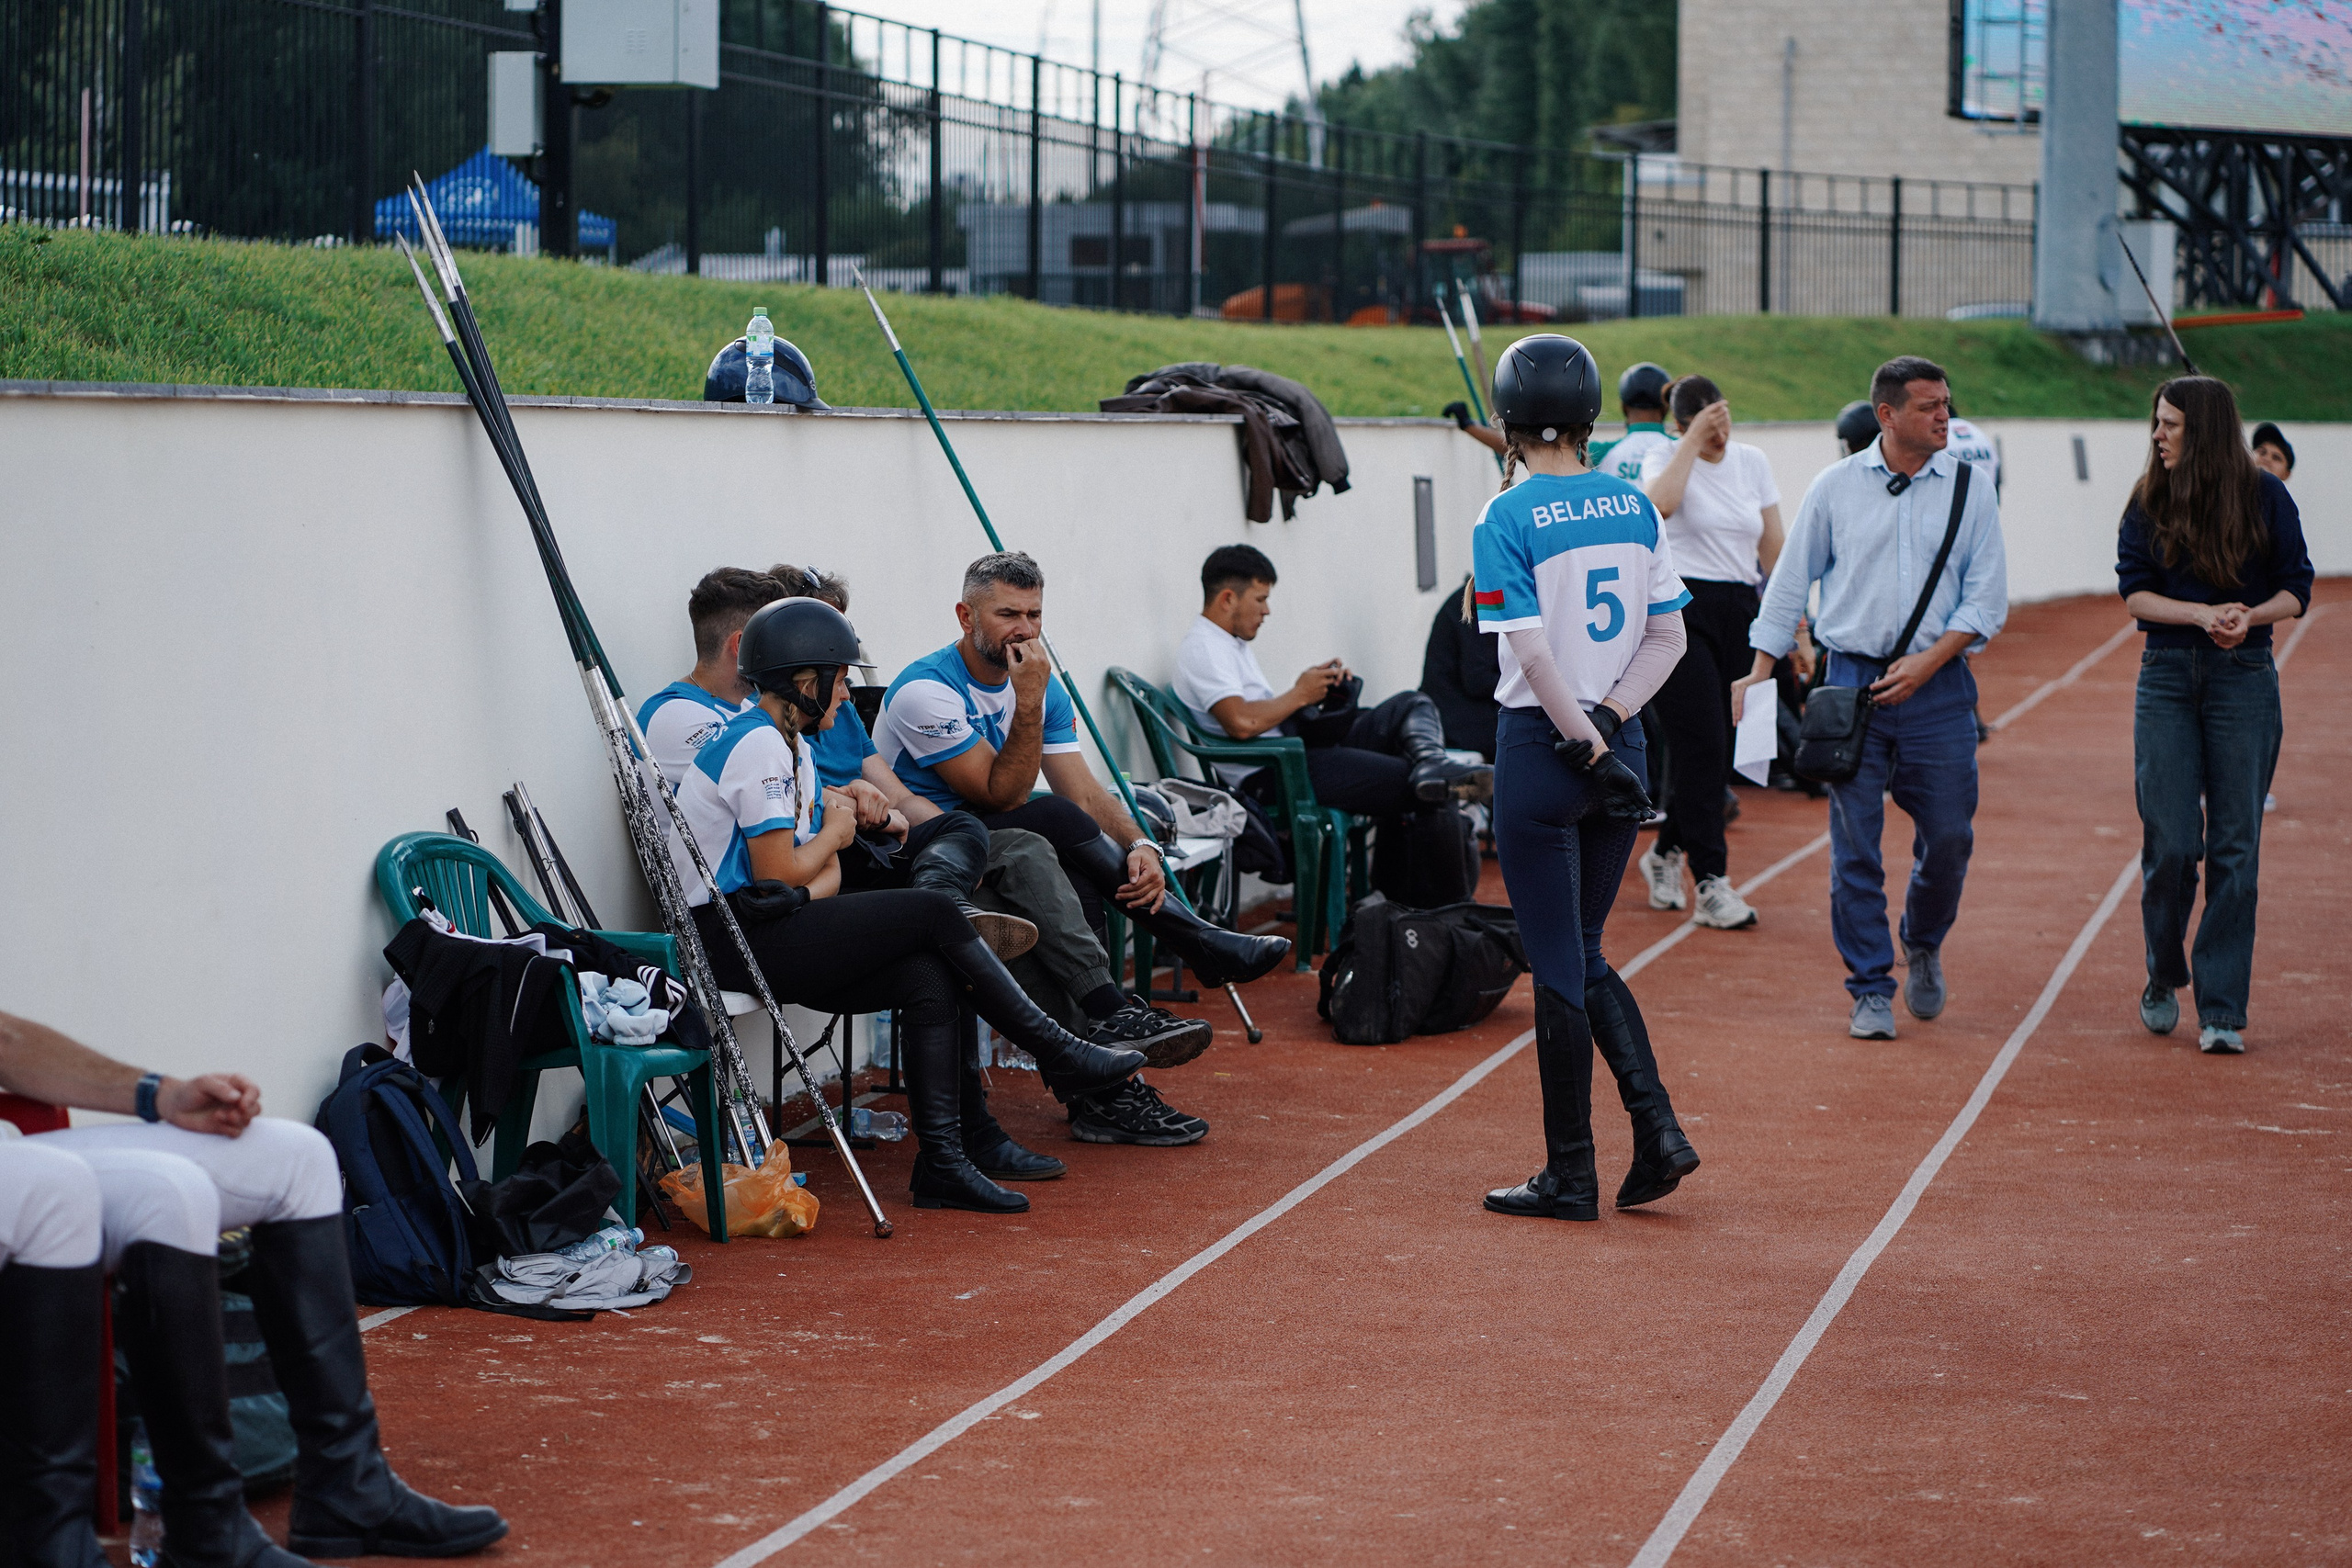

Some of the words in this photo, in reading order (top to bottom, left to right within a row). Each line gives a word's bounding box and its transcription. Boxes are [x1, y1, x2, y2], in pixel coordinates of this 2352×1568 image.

[1618, 462, 1643, 480] SU
[1532, 494, 1640, 528] BELARUS
[1586, 566, 1626, 643] 5
[684, 728, 705, 745] ITPF
[761, 776, 780, 785] ITPF
